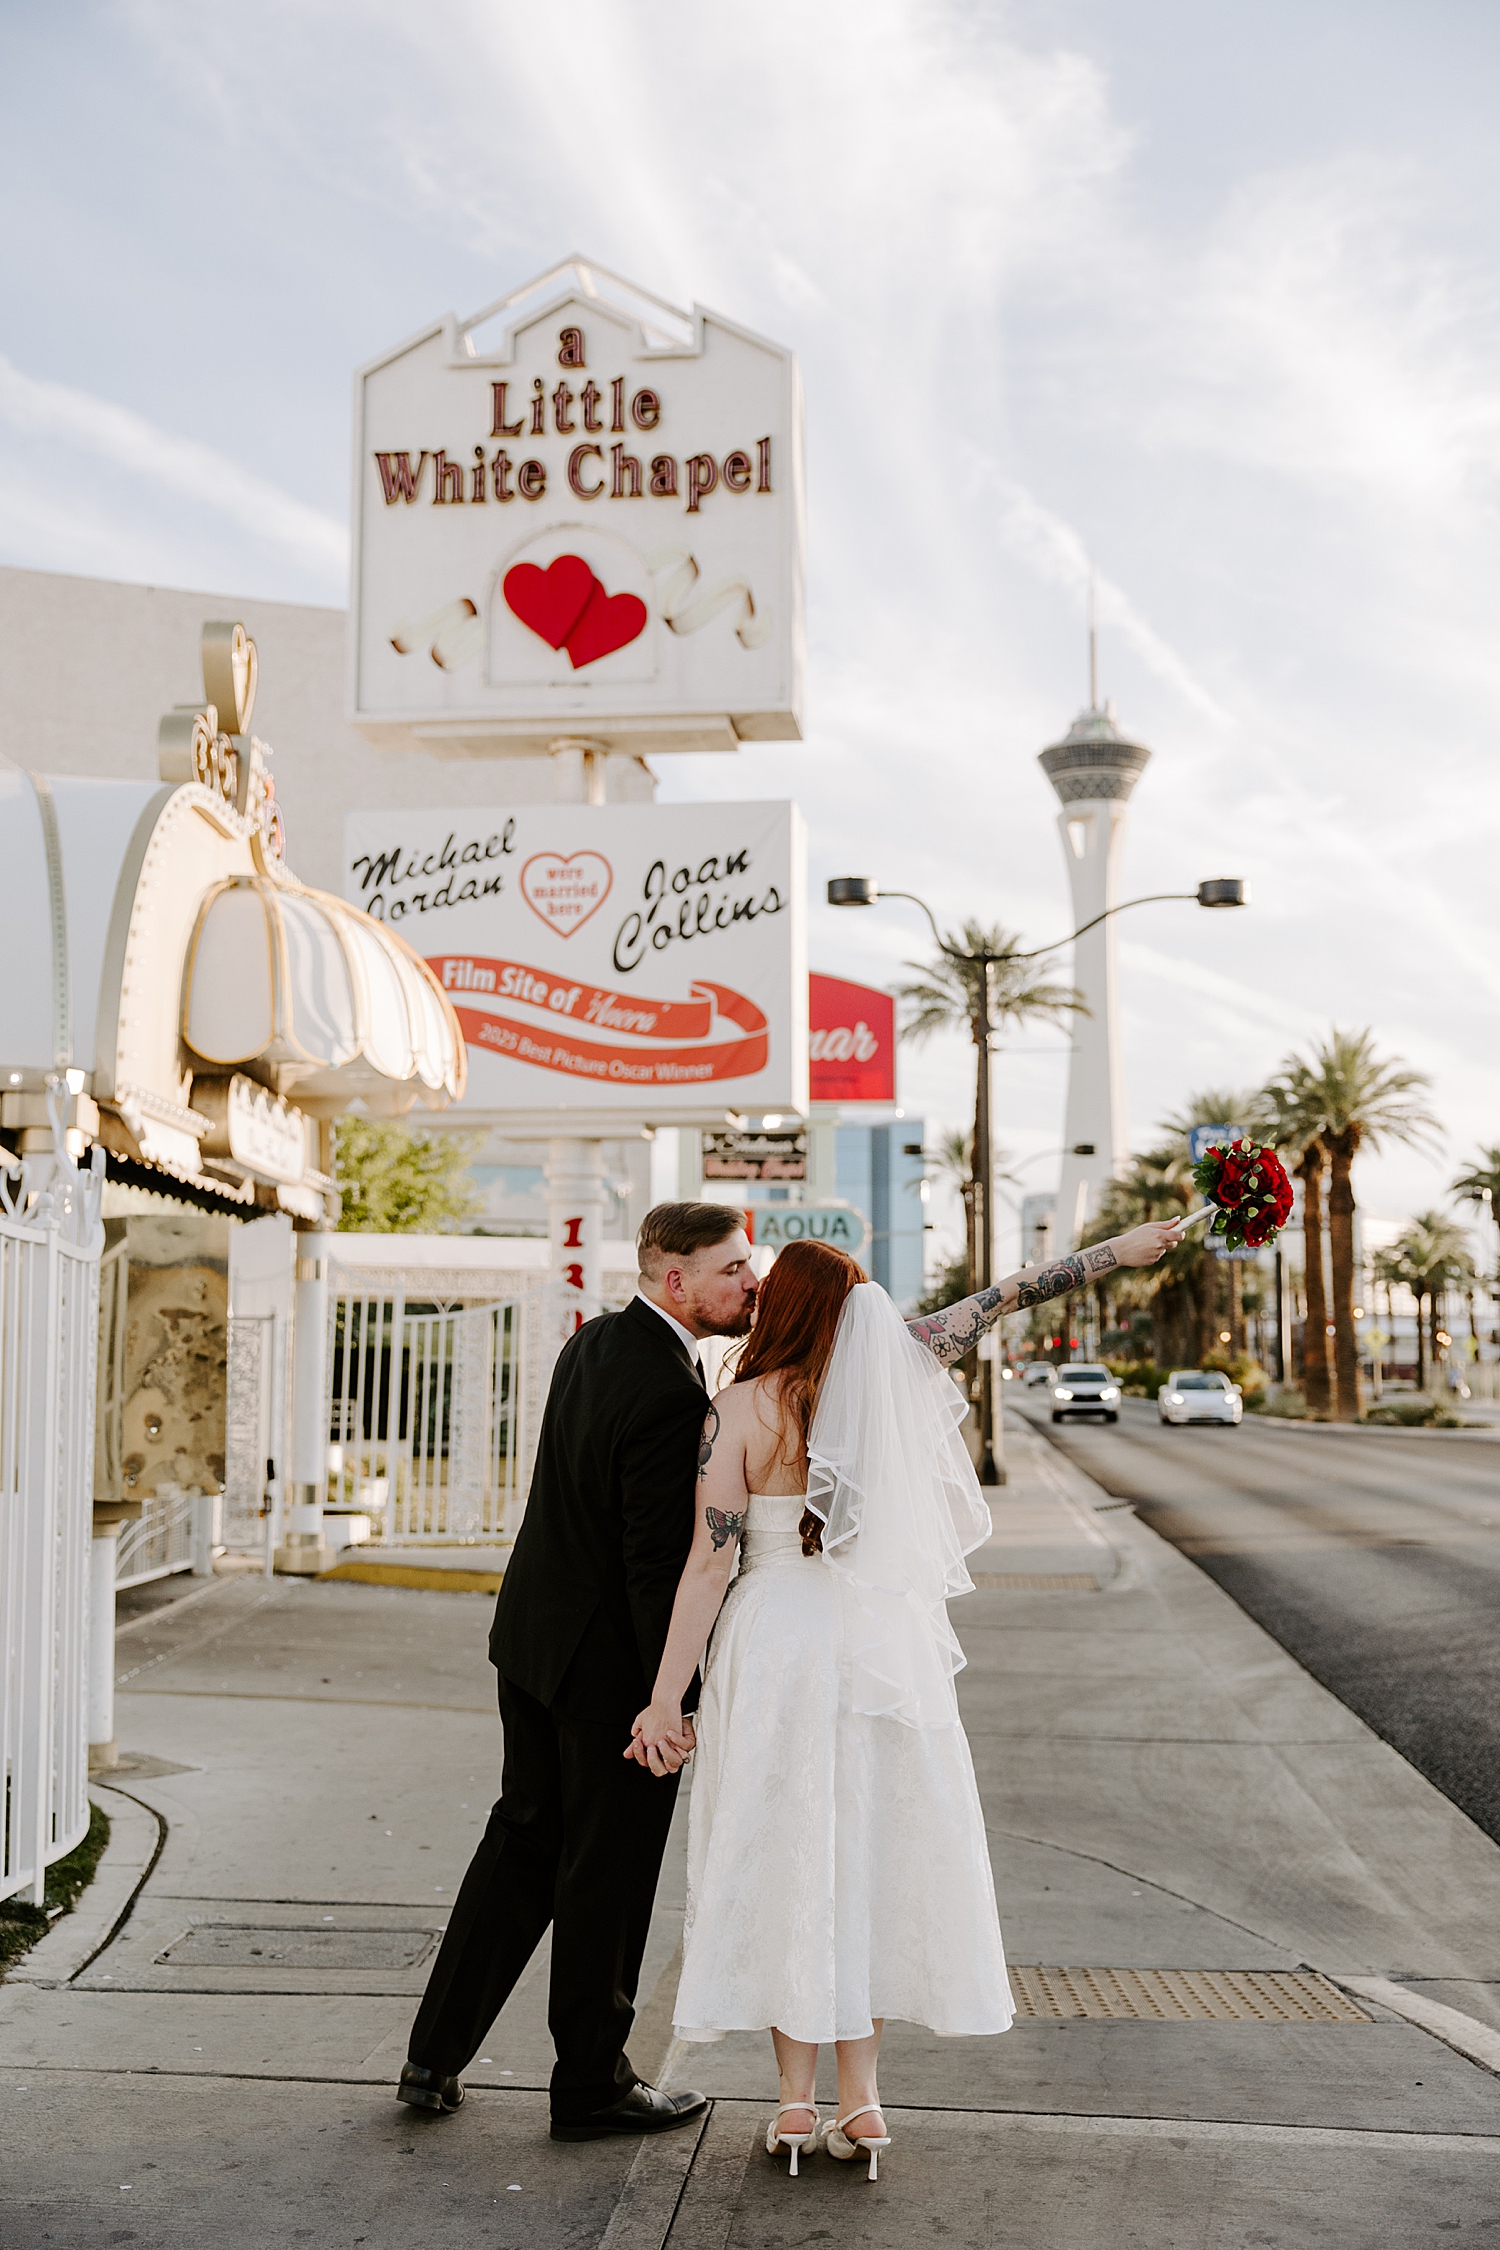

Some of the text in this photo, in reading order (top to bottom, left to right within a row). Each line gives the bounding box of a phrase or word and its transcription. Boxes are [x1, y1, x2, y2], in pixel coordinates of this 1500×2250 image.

[558, 326, 587, 369] a
[490, 376, 661, 437] Little
[374, 437, 772, 512] White Chapel
[352, 816, 517, 890] Michael
[547, 868, 583, 880] were
[533, 883, 598, 898] married
[547, 901, 582, 916] here
[644, 849, 751, 924] Joan
[612, 886, 788, 973] Collins
[442, 959, 496, 991] Film
[498, 966, 548, 1004] Site
[548, 986, 583, 1014] of
[517, 1036, 553, 1063] Best
[551, 1047, 608, 1077] Picture
[608, 1059, 654, 1080] Oscar
[655, 1062, 714, 1080] Winner
[761, 1214, 850, 1239] AQUA
